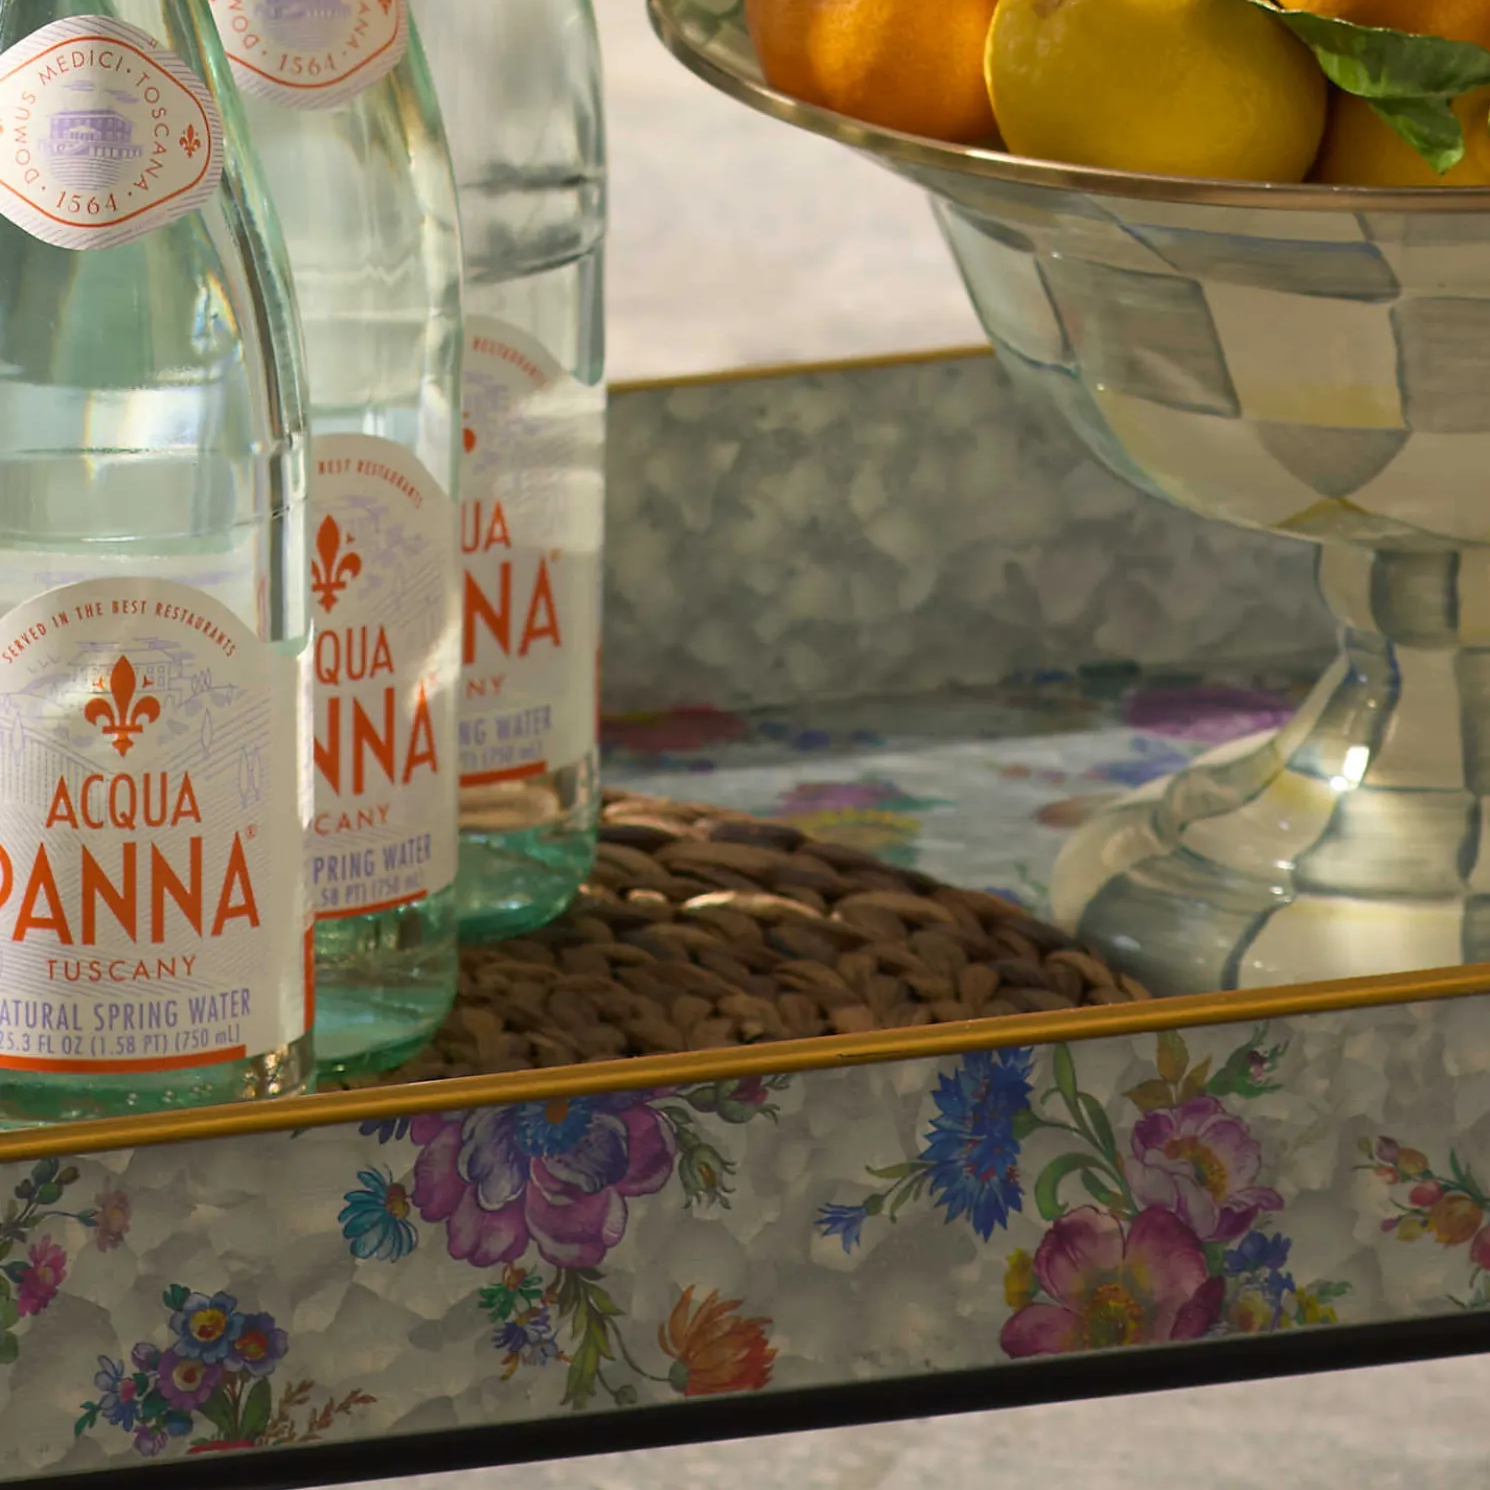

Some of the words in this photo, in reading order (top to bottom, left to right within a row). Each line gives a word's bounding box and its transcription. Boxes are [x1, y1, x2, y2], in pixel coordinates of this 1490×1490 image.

[278, 52, 338, 77] 1564
[13, 89, 41, 185] DOMUS
[38, 48, 124, 87] MEDICI
[133, 71, 170, 192] TOSCANA
[56, 189, 118, 216] 1564
[1, 622, 48, 664] SERVED
[52, 612, 70, 629] IN
[75, 601, 104, 622] THE
[111, 598, 148, 616] BEST
[155, 601, 238, 658] RESTAURANTS
[315, 624, 395, 687] QUA
[313, 677, 439, 798] NNA
[45, 770, 202, 831] ACQUA
[313, 801, 390, 838] CANY
[312, 848, 376, 885] PRING
[46, 954, 196, 983] TUSCANY
[0, 998, 83, 1032] ATURAL
[93, 999, 178, 1032] SPRING
[188, 988, 251, 1025] WATER
[38, 1033, 56, 1056] FL
[61, 1034, 84, 1056] OZ
[90, 1035, 136, 1058] (1.58
[143, 1033, 168, 1056] PT)
[175, 1028, 209, 1053] (750
